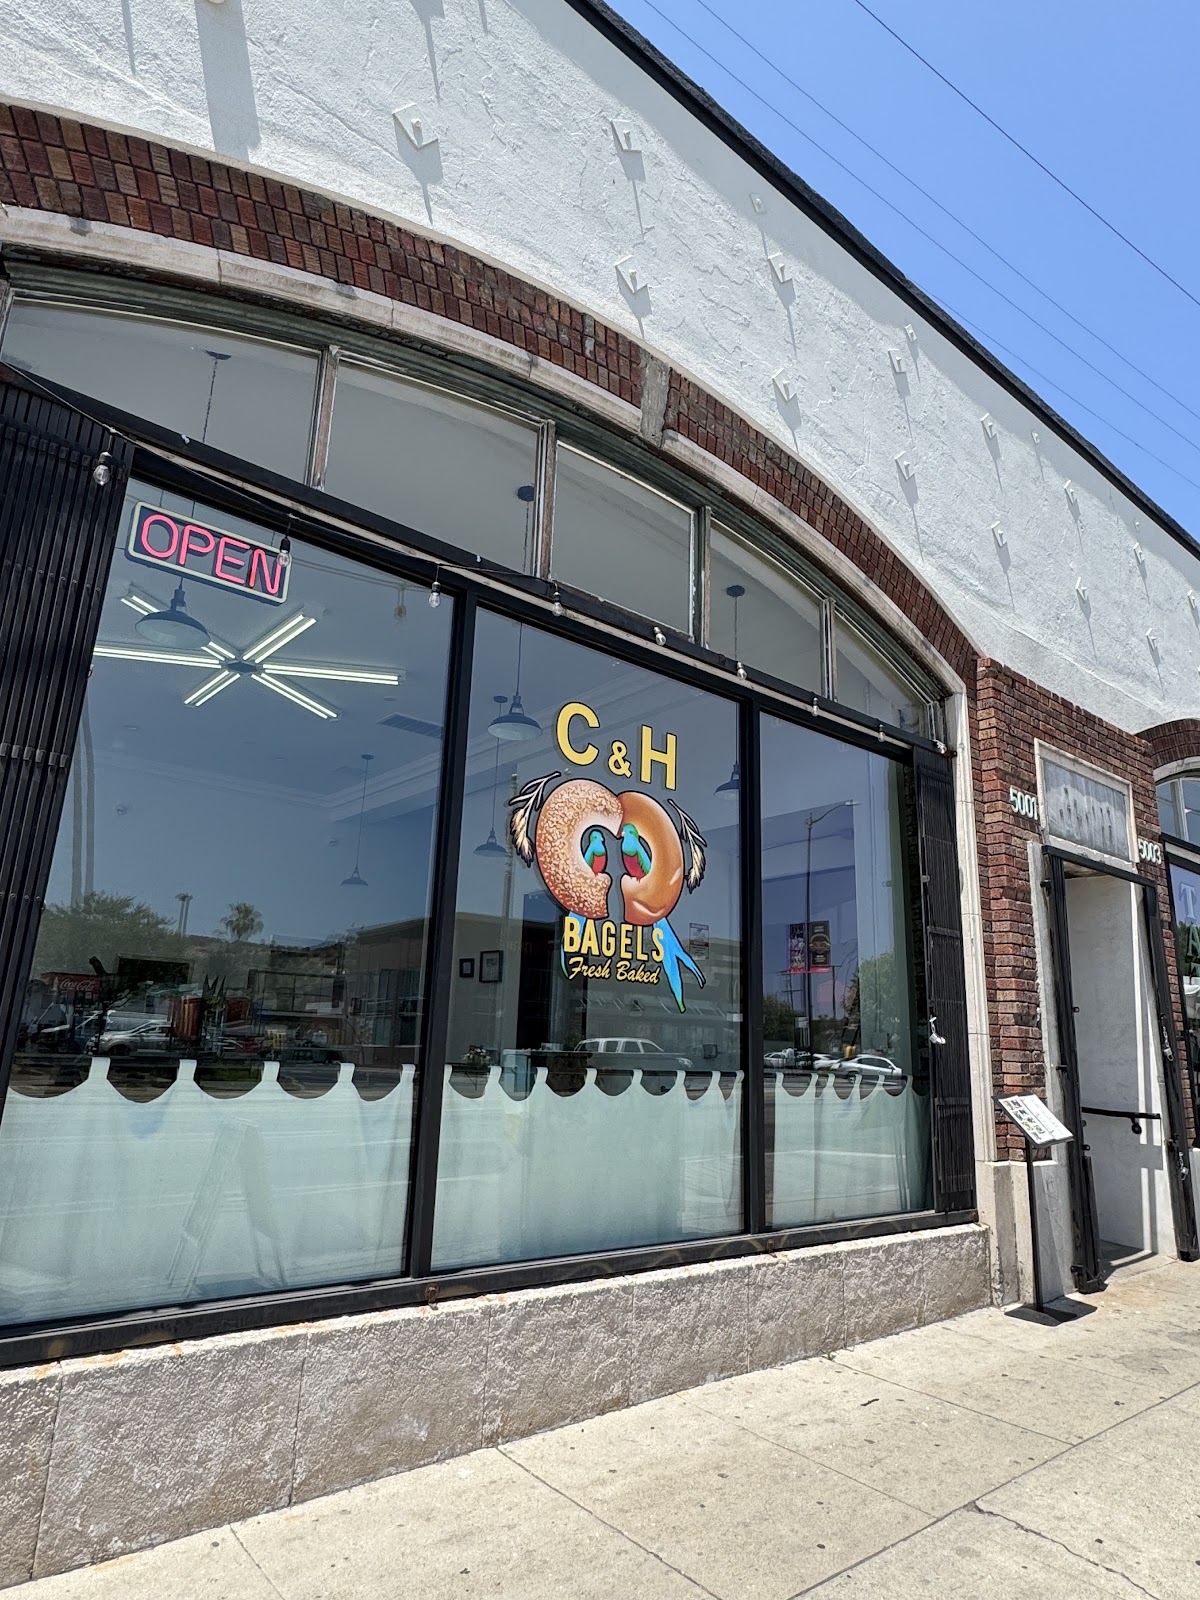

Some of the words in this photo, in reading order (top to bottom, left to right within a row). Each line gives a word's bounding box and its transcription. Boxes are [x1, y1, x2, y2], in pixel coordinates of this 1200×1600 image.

[141, 514, 282, 594] OPEN
[556, 701, 600, 766] C
[608, 740, 632, 778] &
[640, 724, 677, 791] H
[1009, 787, 1038, 820] 5001
[1137, 838, 1162, 865] 5003
[563, 916, 665, 962] BAGELS
[568, 956, 612, 980] Fresh
[616, 960, 661, 984] Baked
